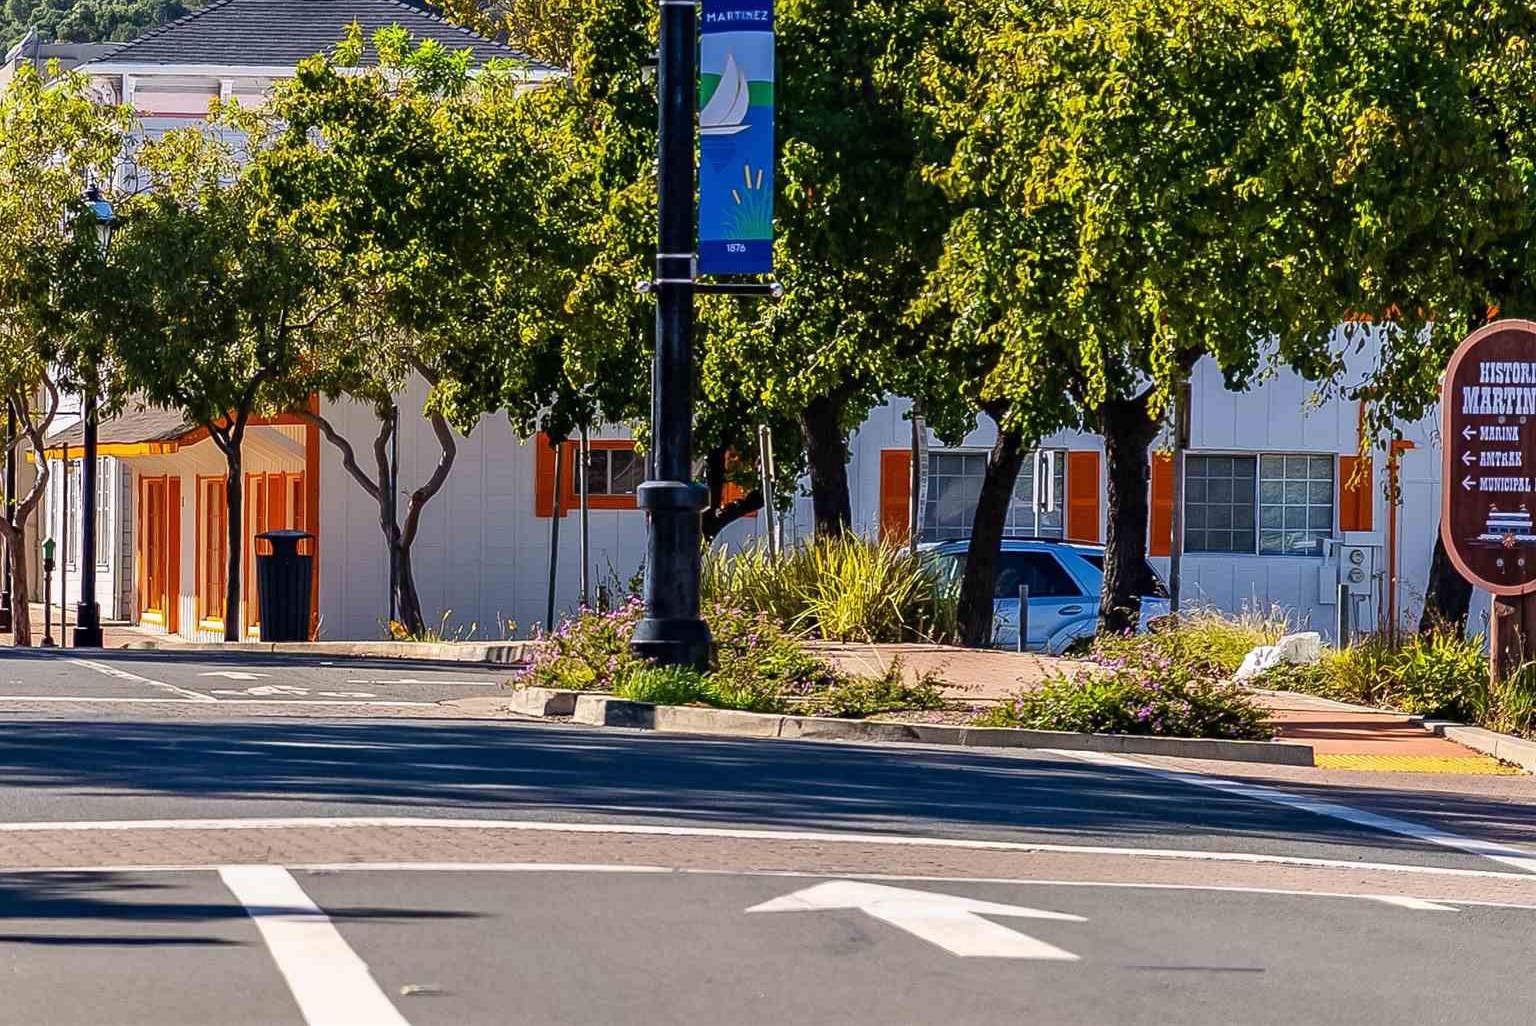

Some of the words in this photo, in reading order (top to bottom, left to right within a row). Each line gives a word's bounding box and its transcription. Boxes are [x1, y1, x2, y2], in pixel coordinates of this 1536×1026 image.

[706, 10, 768, 22] MARTINEZ
[726, 243, 746, 253] 1876
[1480, 426, 1519, 441] MARINA
[1480, 451, 1522, 467] AMTRAK
[1480, 477, 1531, 492] MUNICIPAL
